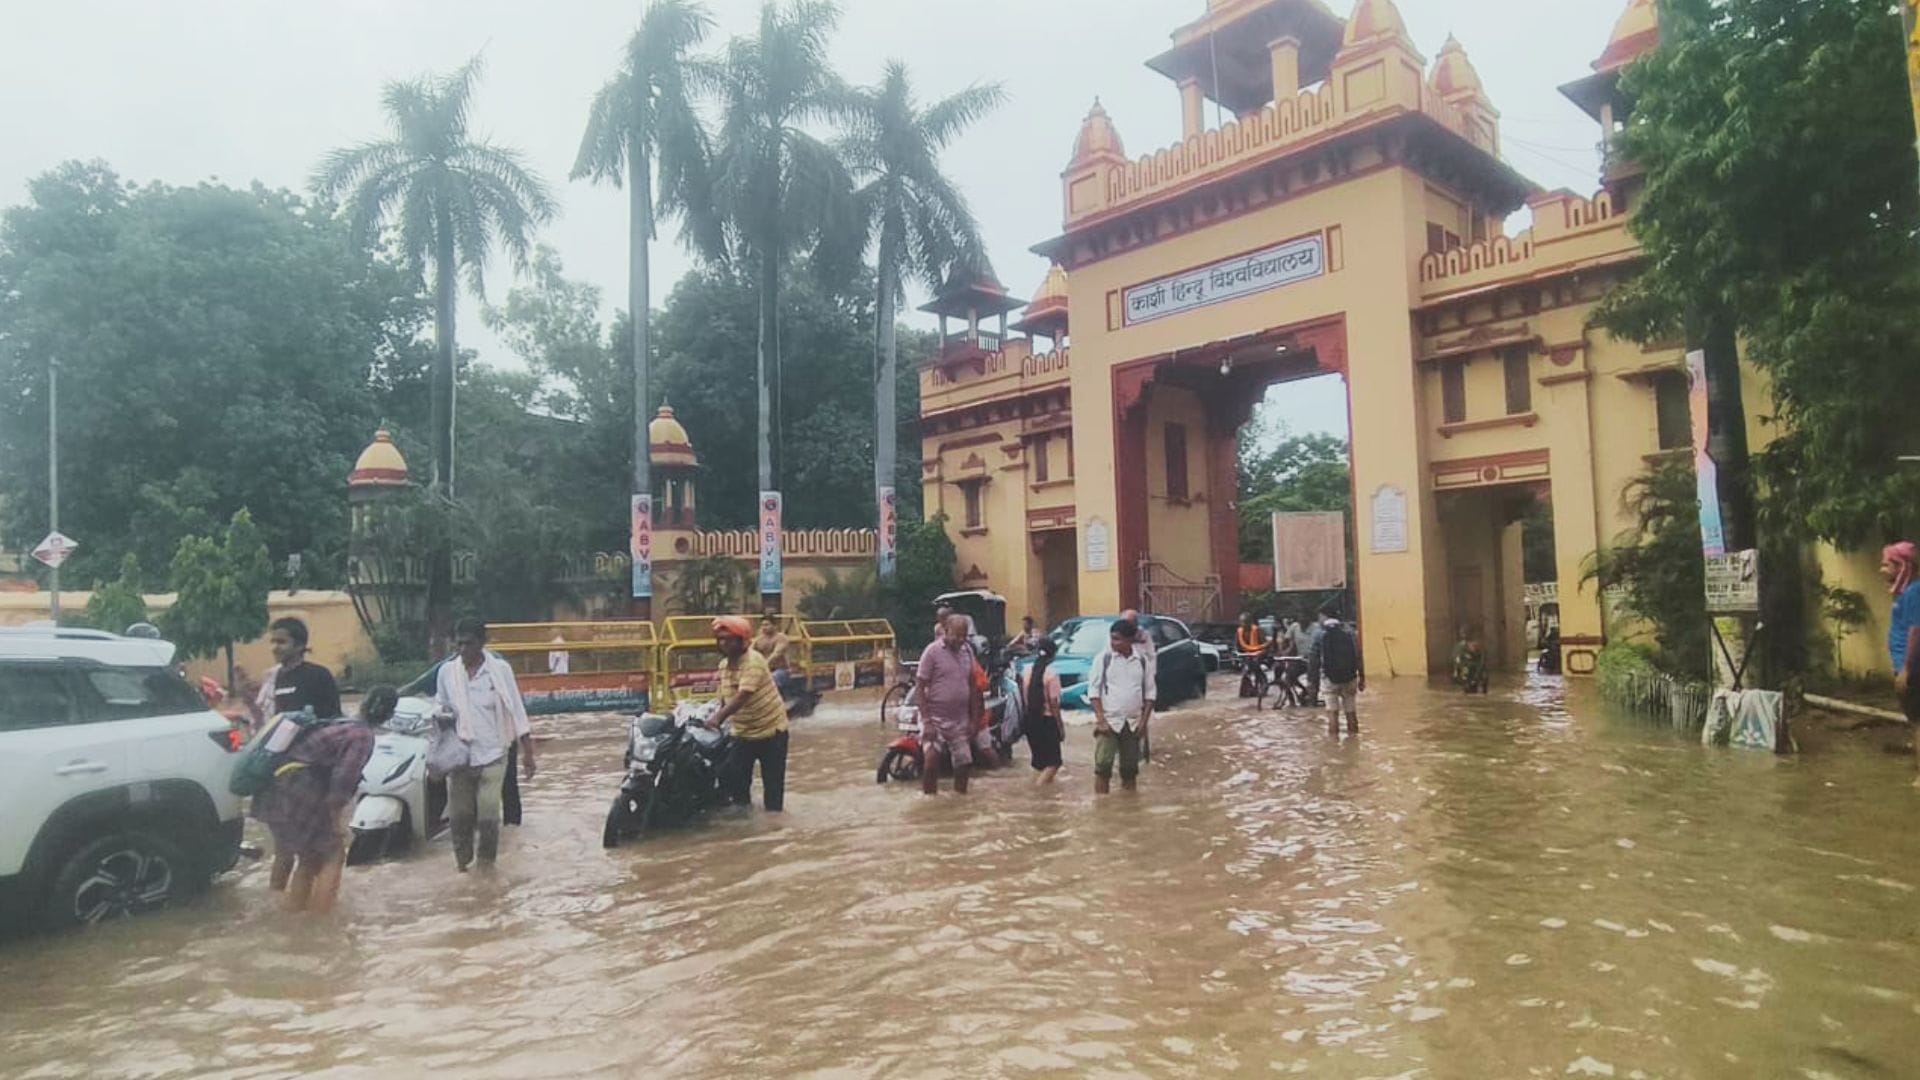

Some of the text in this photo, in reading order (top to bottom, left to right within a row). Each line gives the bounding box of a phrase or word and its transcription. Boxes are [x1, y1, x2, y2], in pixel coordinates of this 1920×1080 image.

[1131, 247, 1316, 311] काशी हिन्दू विश्वविद्यालय
[639, 520, 650, 575] ABVP
[764, 518, 775, 571] ABVP
